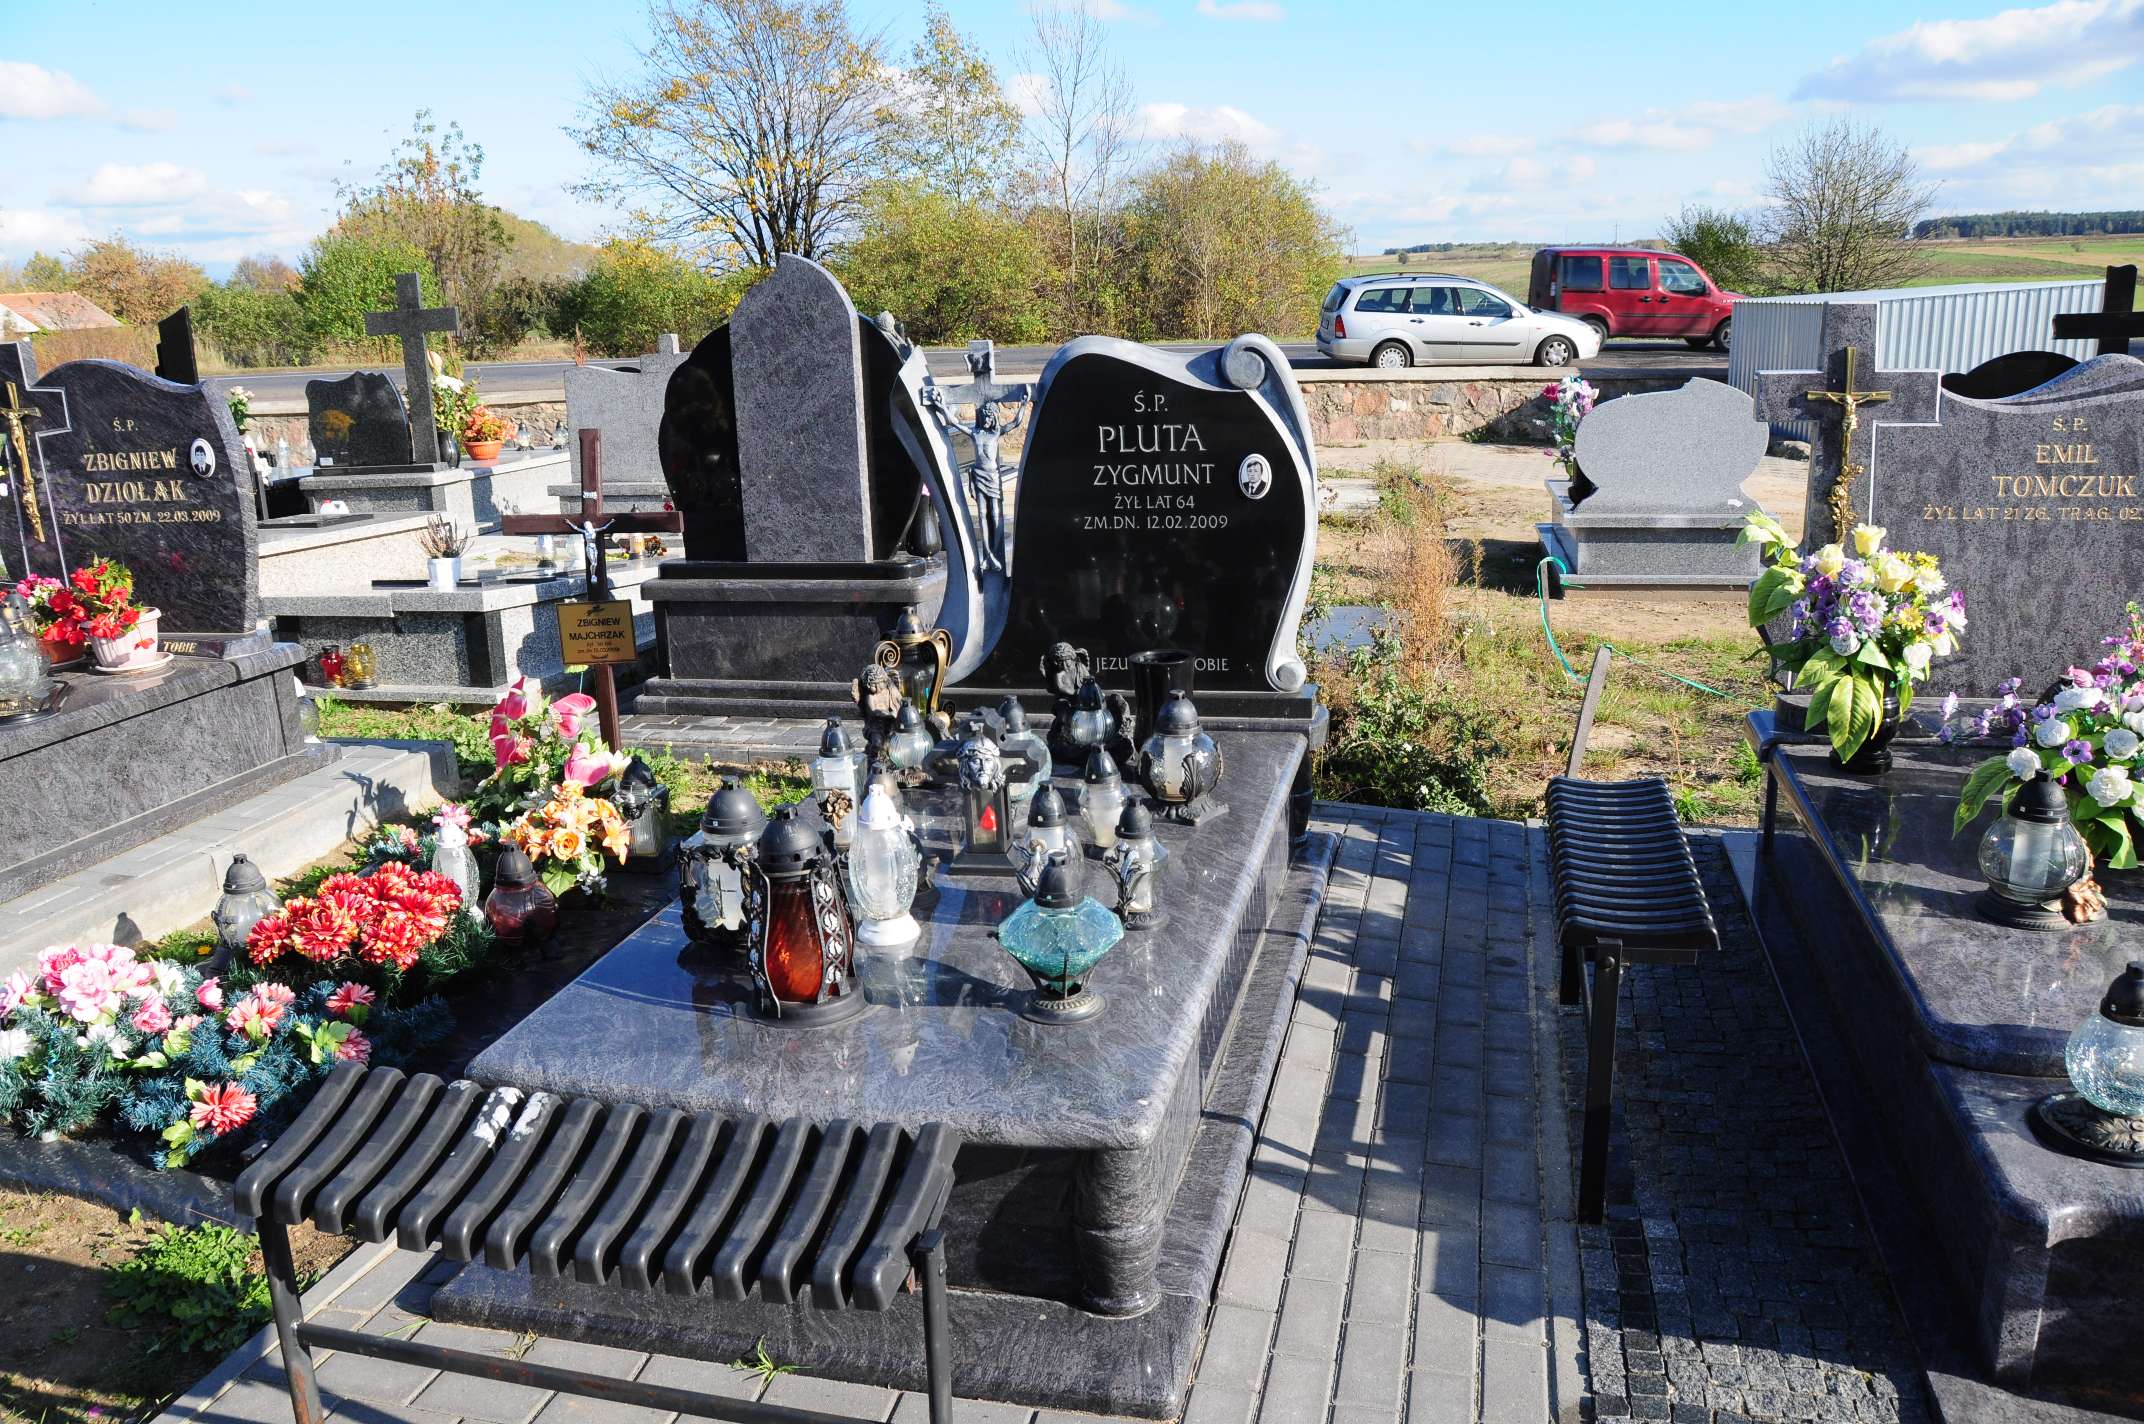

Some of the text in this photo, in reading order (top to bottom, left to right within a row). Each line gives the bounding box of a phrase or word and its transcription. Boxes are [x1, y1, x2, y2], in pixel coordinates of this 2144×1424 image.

[1098, 424, 1206, 453] PLUTA
[83, 448, 177, 472] ZBIGNIEW
[2036, 444, 2099, 464] EMIL
[1093, 463, 1215, 486] ZYGMUNT
[86, 480, 188, 504] DZIOŁAK
[1992, 475, 2137, 497] TOMCZUK
[1114, 492, 1196, 509] ŻYŁ LAT 64
[89, 512, 114, 524] LAT
[117, 512, 132, 524] 50
[157, 510, 221, 523] 22.03.2009
[1963, 507, 1999, 520] LAT
[1146, 515, 1228, 529] 12.02.2009
[577, 617, 620, 627] ZBIGNIEW
[569, 631, 625, 640] MAJCHRZAK
[163, 641, 197, 653] TOBIE
[1096, 657, 1229, 673] JEZU OBIE
